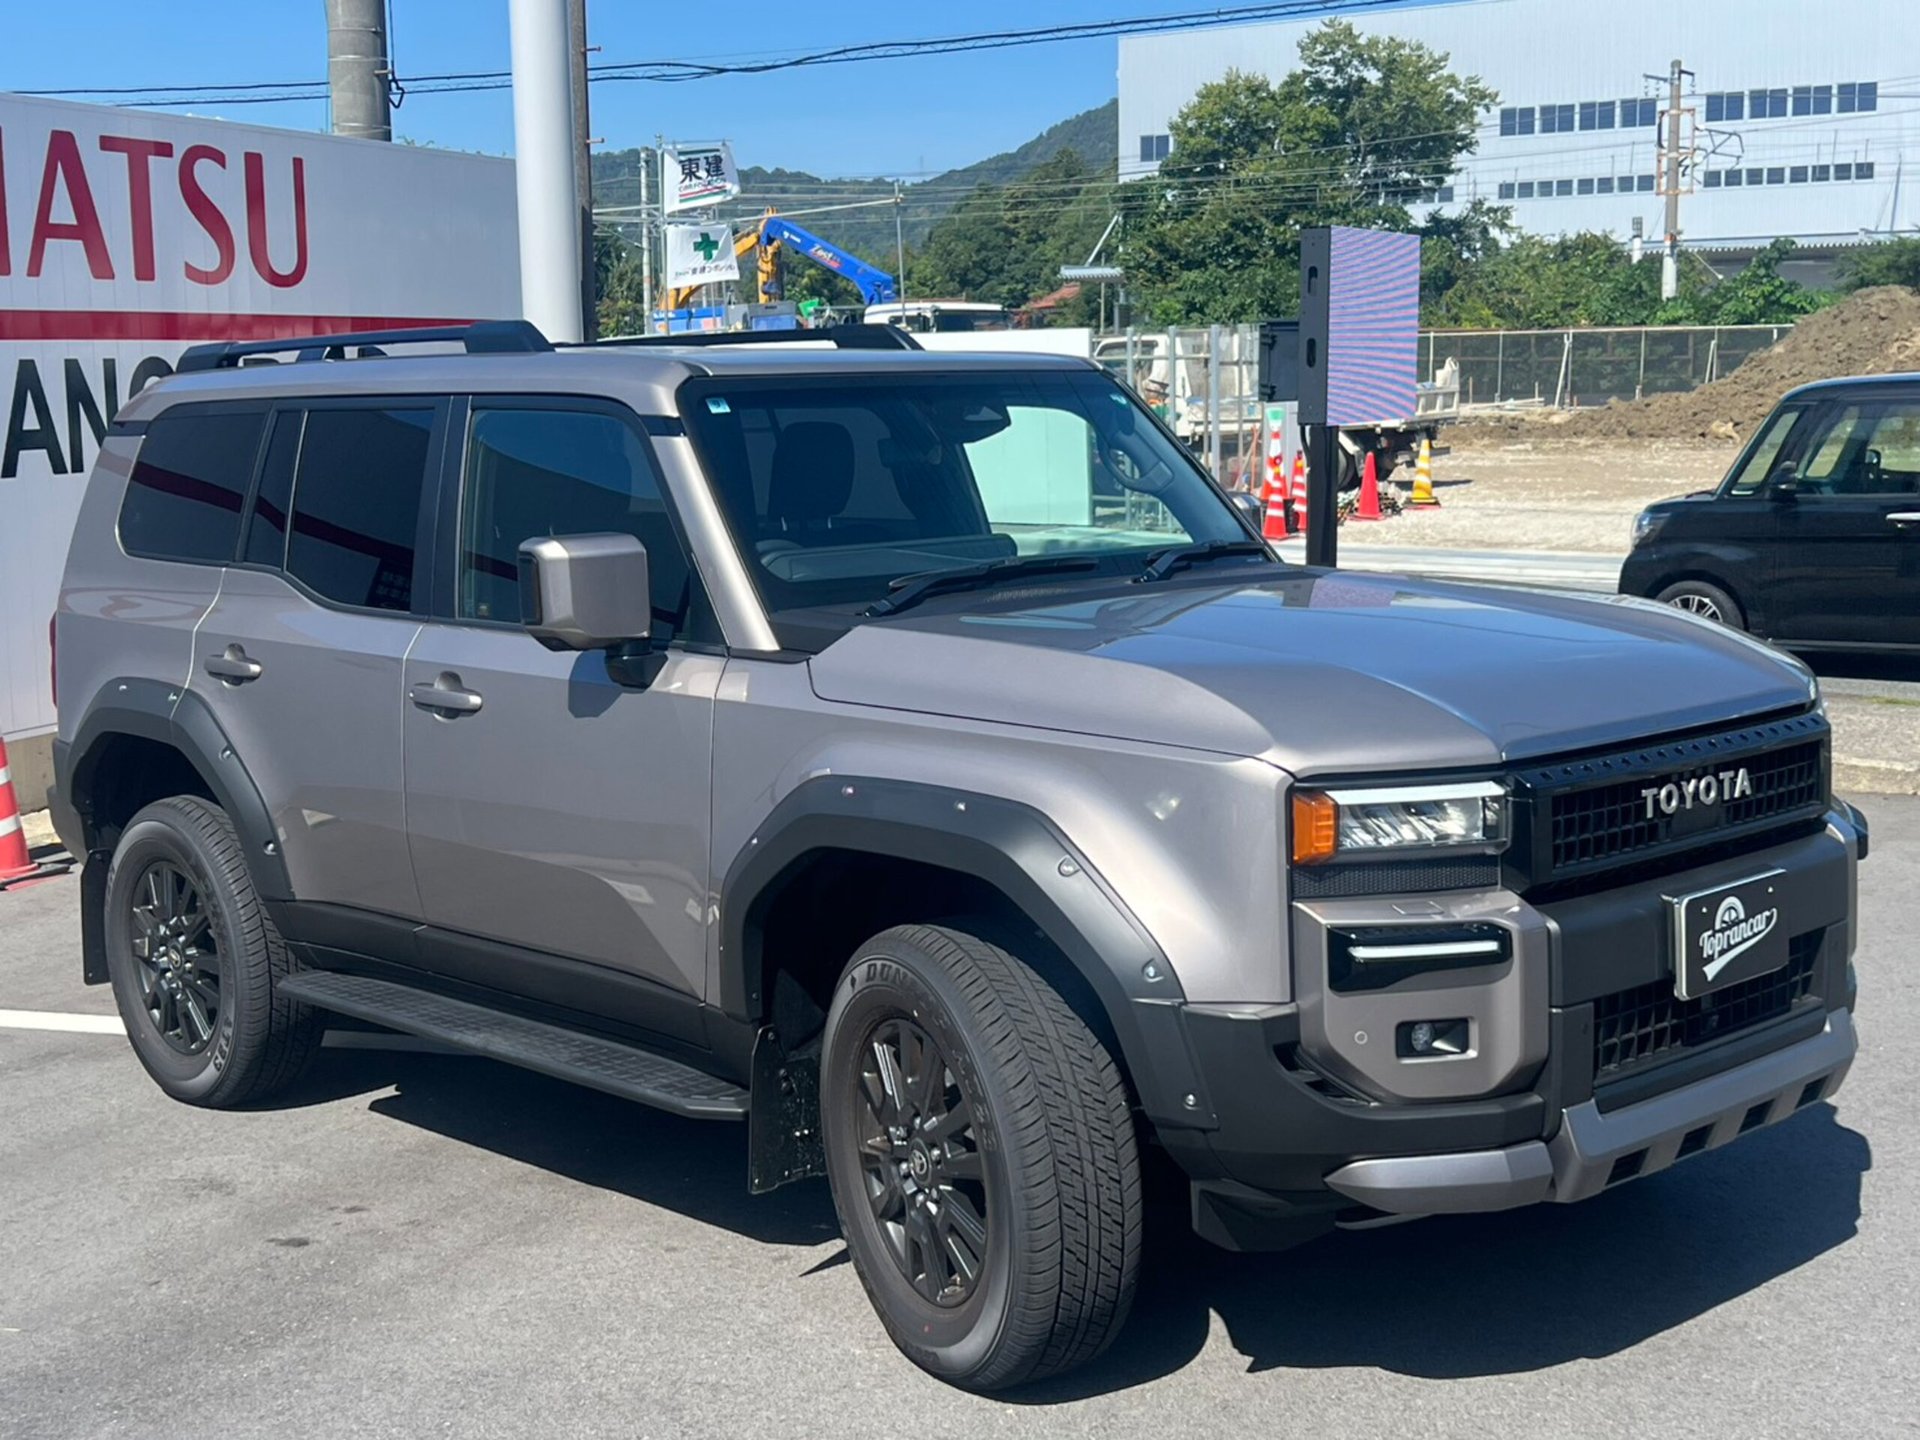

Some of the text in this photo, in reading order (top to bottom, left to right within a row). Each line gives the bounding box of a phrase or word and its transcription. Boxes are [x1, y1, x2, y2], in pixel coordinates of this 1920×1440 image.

[678, 154, 725, 184] 東建
[0, 126, 308, 288] ATSU
[1641, 767, 1752, 819] TOYOTA
[1699, 909, 1777, 960] Toprancar
